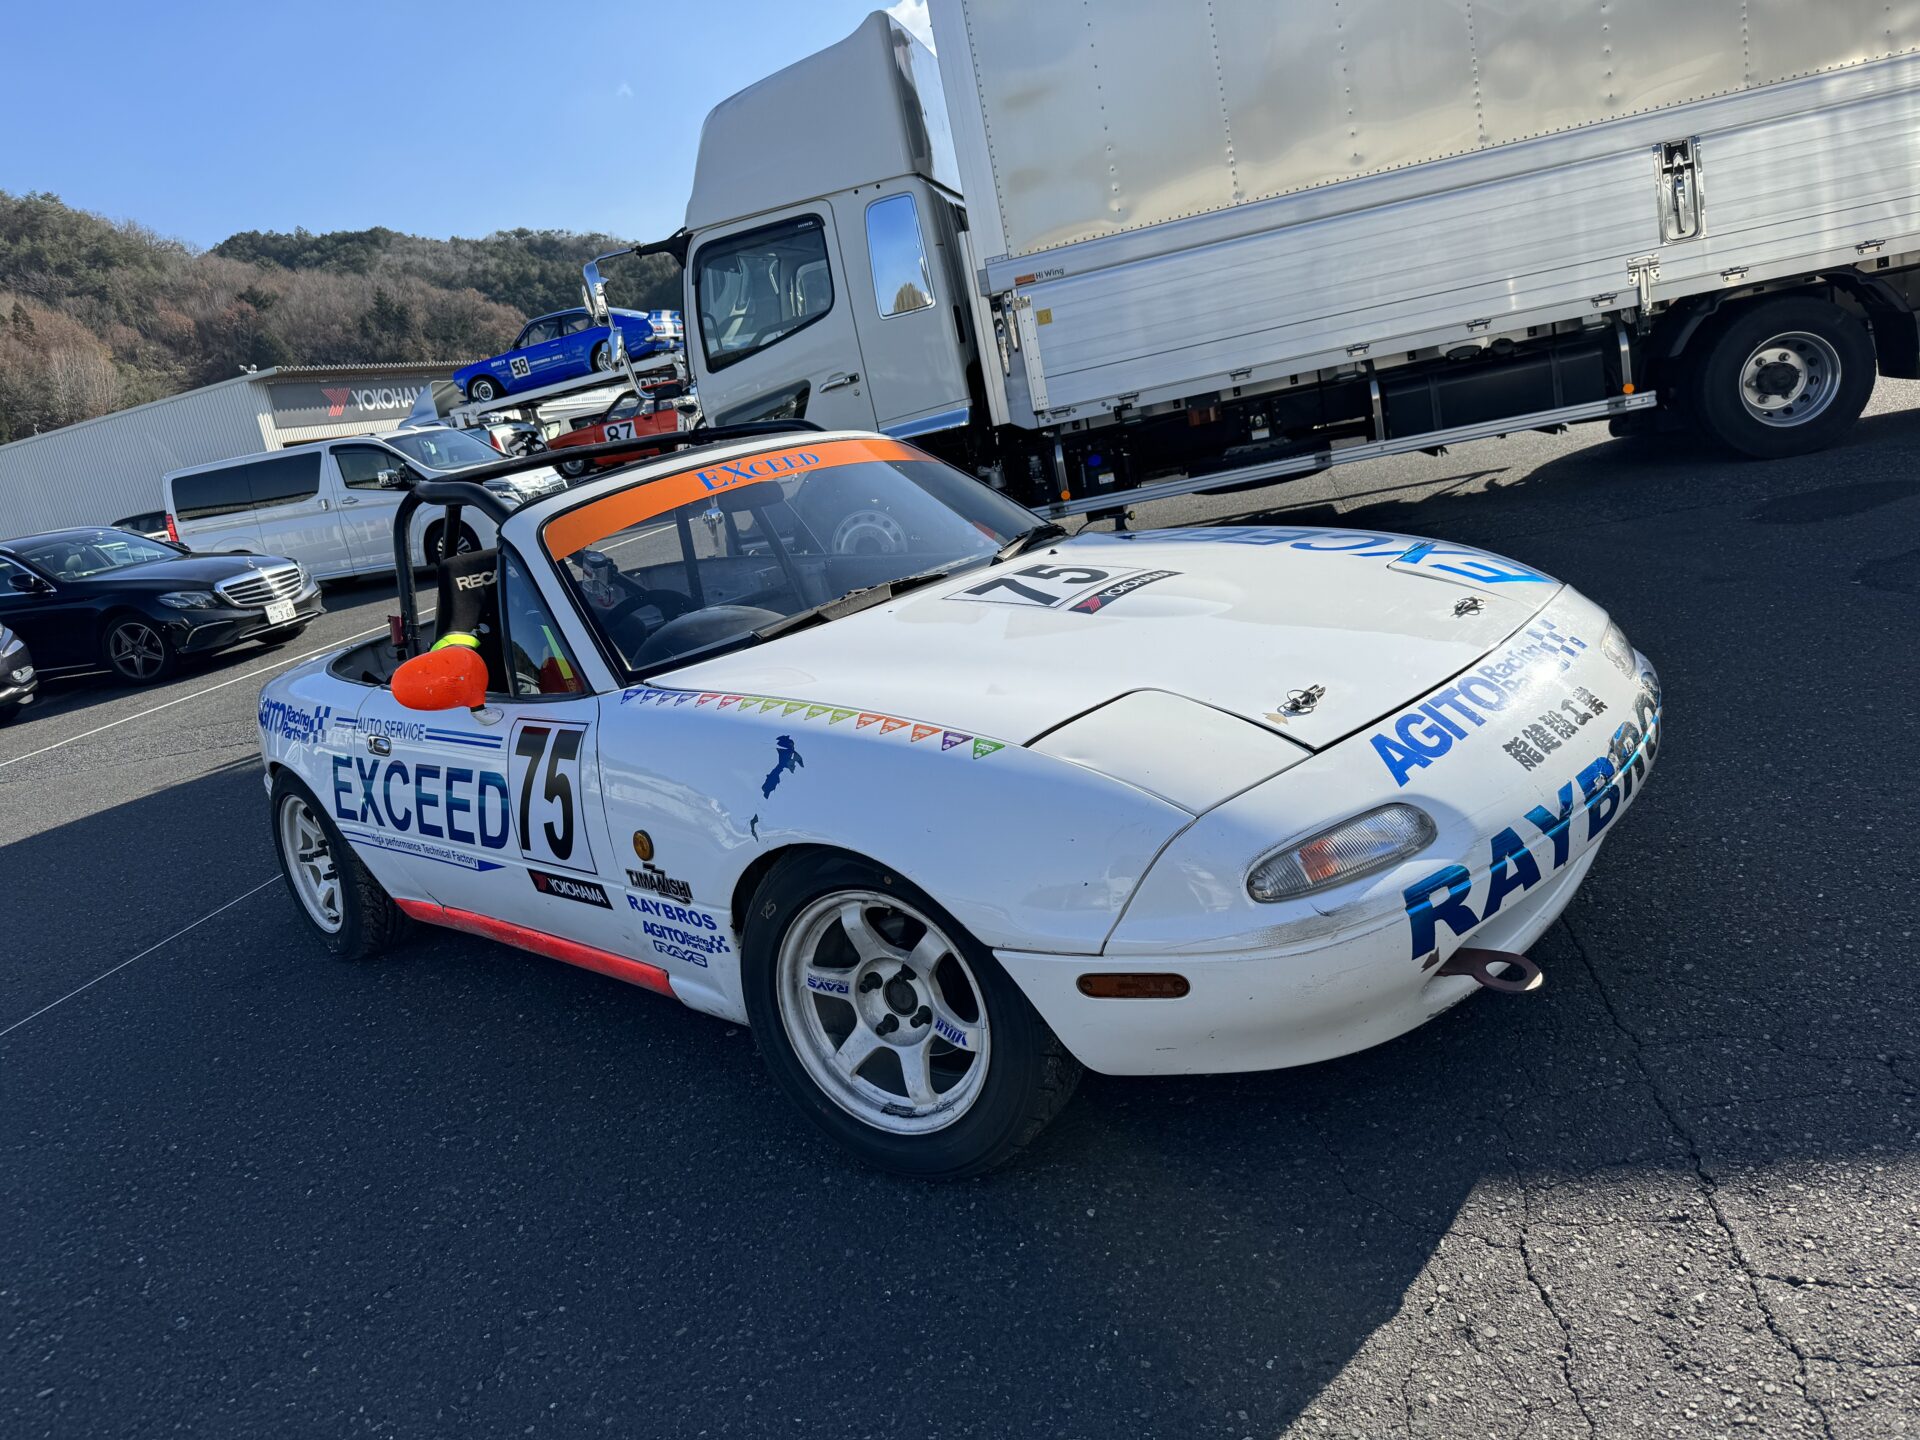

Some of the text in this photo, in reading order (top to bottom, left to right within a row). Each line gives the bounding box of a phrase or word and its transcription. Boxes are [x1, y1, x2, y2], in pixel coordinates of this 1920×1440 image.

[1045, 268, 1065, 278] Wing
[511, 358, 529, 376] 58
[606, 422, 633, 441] 87
[695, 452, 821, 491] EXCEED
[963, 564, 1109, 606] 75
[1098, 571, 1176, 597] YOKOHAMA
[286, 704, 311, 732] Racing
[357, 716, 426, 741] AUTO SERVICE
[1370, 642, 1541, 788] AGITO Racin
[281, 721, 302, 741] Parts
[332, 754, 510, 851] EXCEED
[514, 725, 585, 861] 75
[384, 837, 423, 852] performance
[421, 843, 452, 858] Technical
[452, 851, 478, 867] Factory
[546, 876, 607, 905] YOKOHAMA
[626, 894, 718, 931] RAYBROS
[642, 920, 710, 949] AGITO Racing
[652, 939, 709, 969] RAYS
[807, 977, 849, 994] RAYS
